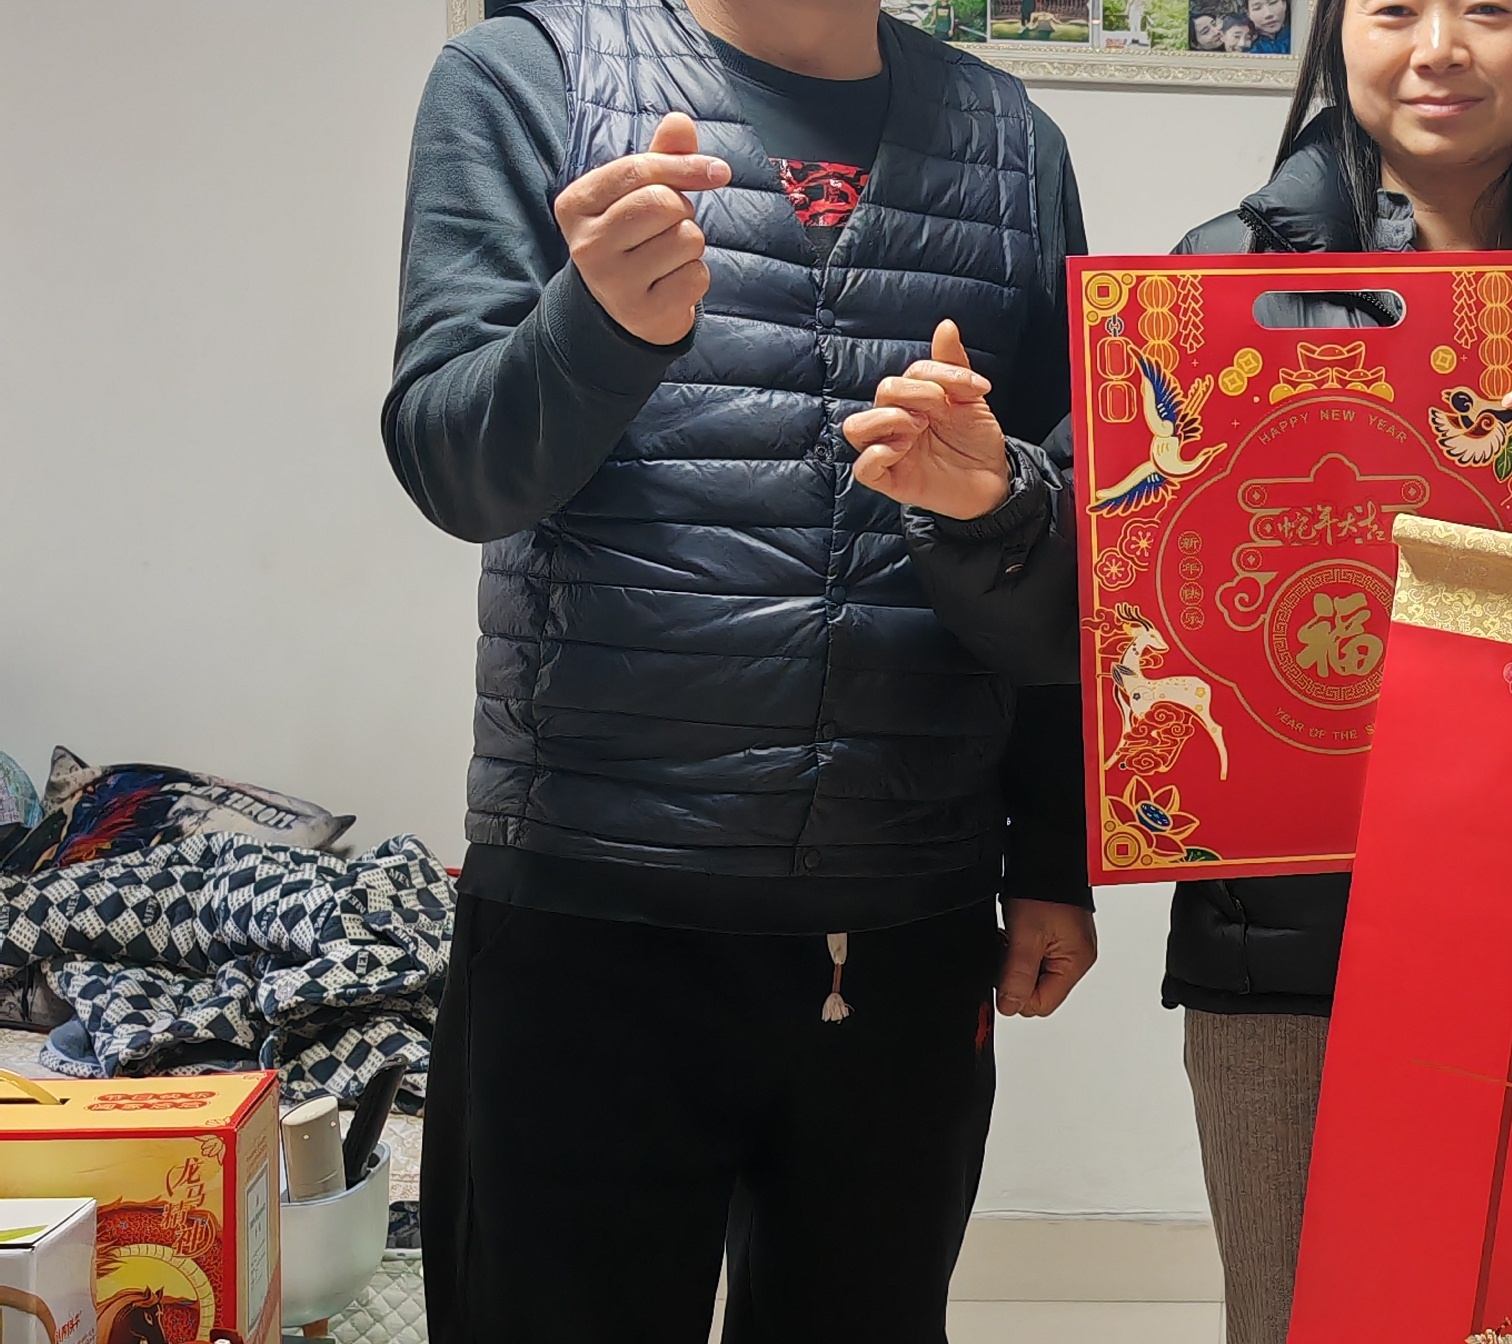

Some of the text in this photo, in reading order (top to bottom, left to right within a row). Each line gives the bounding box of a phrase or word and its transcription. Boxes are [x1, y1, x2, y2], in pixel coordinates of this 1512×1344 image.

[1259, 409, 1408, 445] HAPPY NEW YEAR
[1278, 501, 1386, 546] 蛇年大吉
[1296, 592, 1384, 678] 福
[1275, 706, 1358, 740] YEAR OF THE
